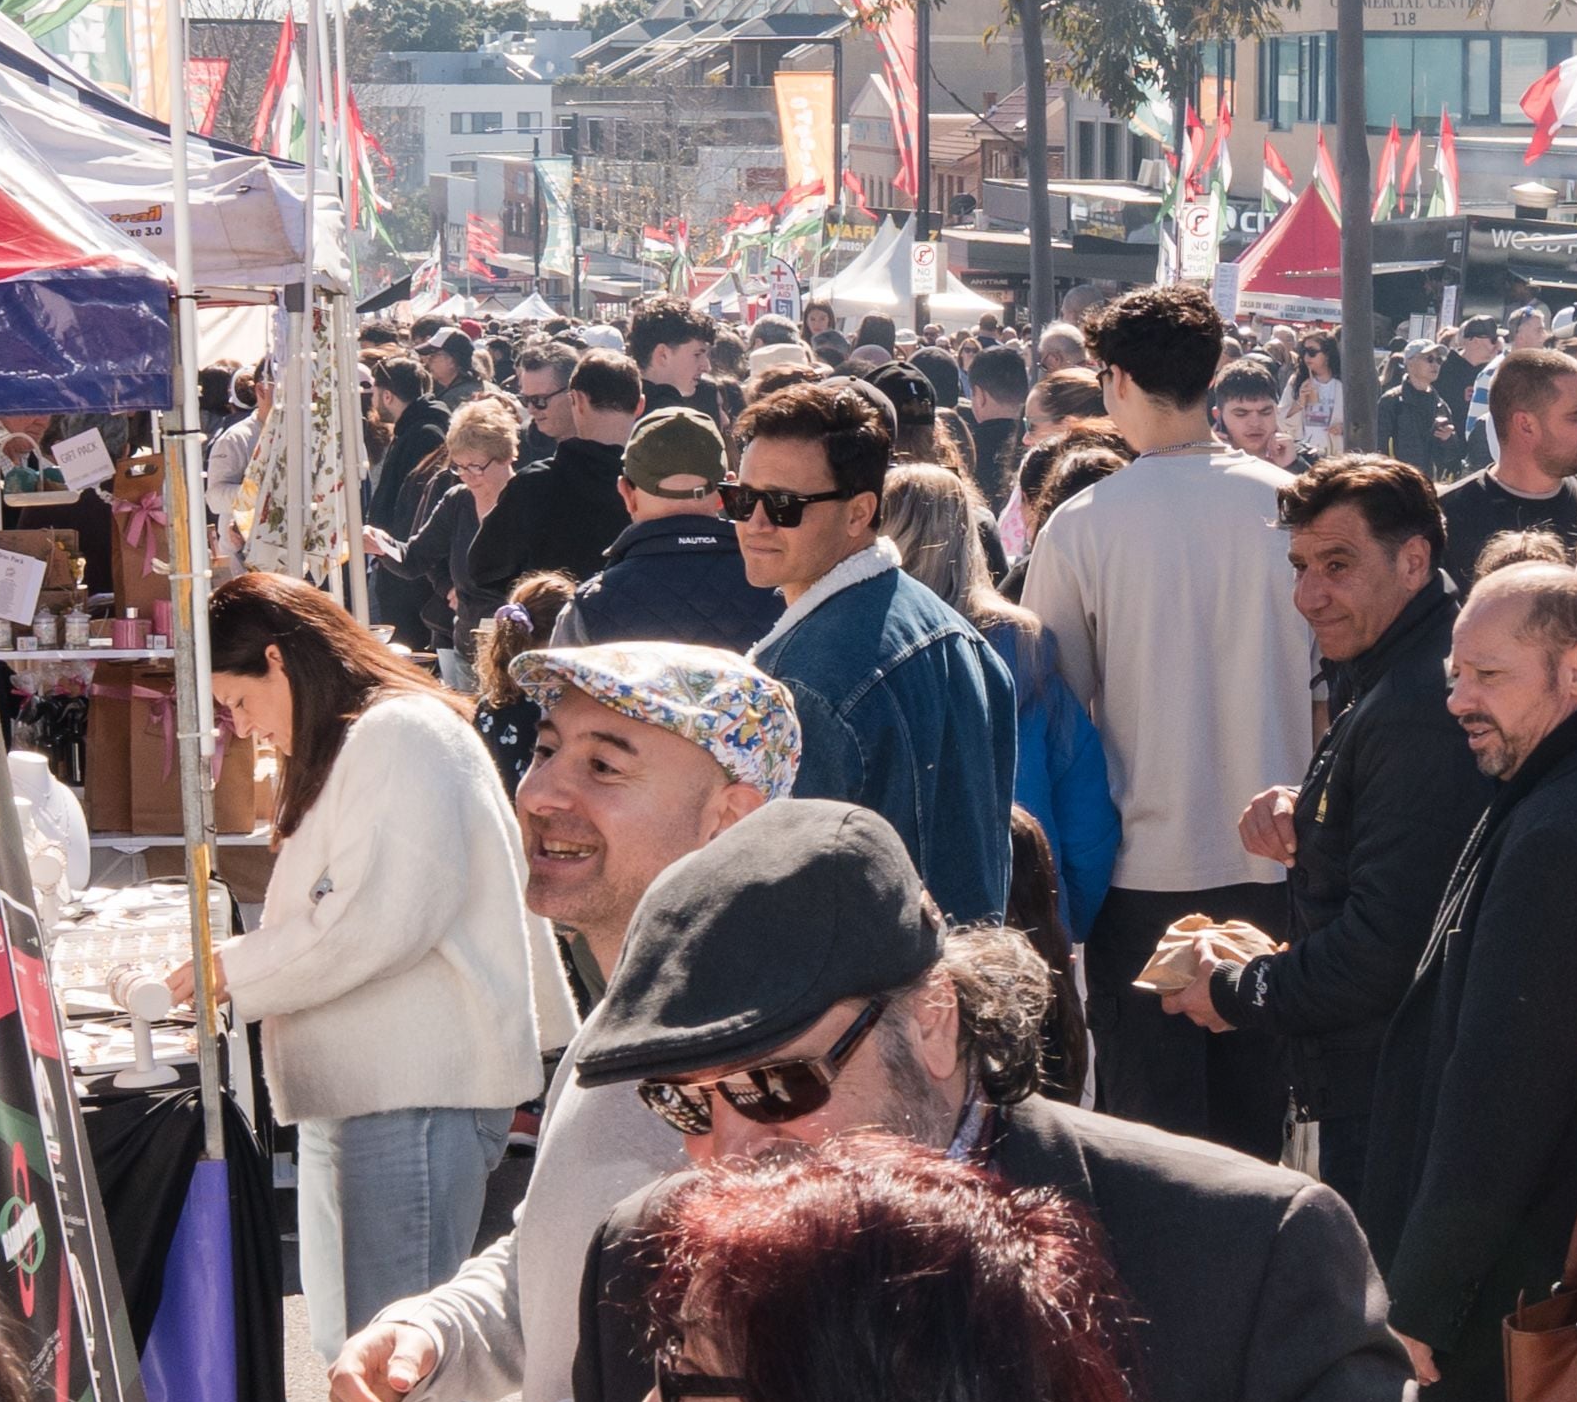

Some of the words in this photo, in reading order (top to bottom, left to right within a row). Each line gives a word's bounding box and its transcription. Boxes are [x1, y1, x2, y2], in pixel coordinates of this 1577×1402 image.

[1393, 11, 1416, 26] 118
[145, 226, 162, 237] 3.0
[1191, 240, 1209, 252] NO
[917, 268, 931, 277] NO
[772, 283, 794, 291] FIRST
[1285, 304, 1306, 312] ITALIAN
[1307, 306, 1341, 315] GINGERBREA
[60, 451, 77, 464] GIFT
[77, 442, 97, 456] PACK
[678, 536, 718, 545] NAUTICA
